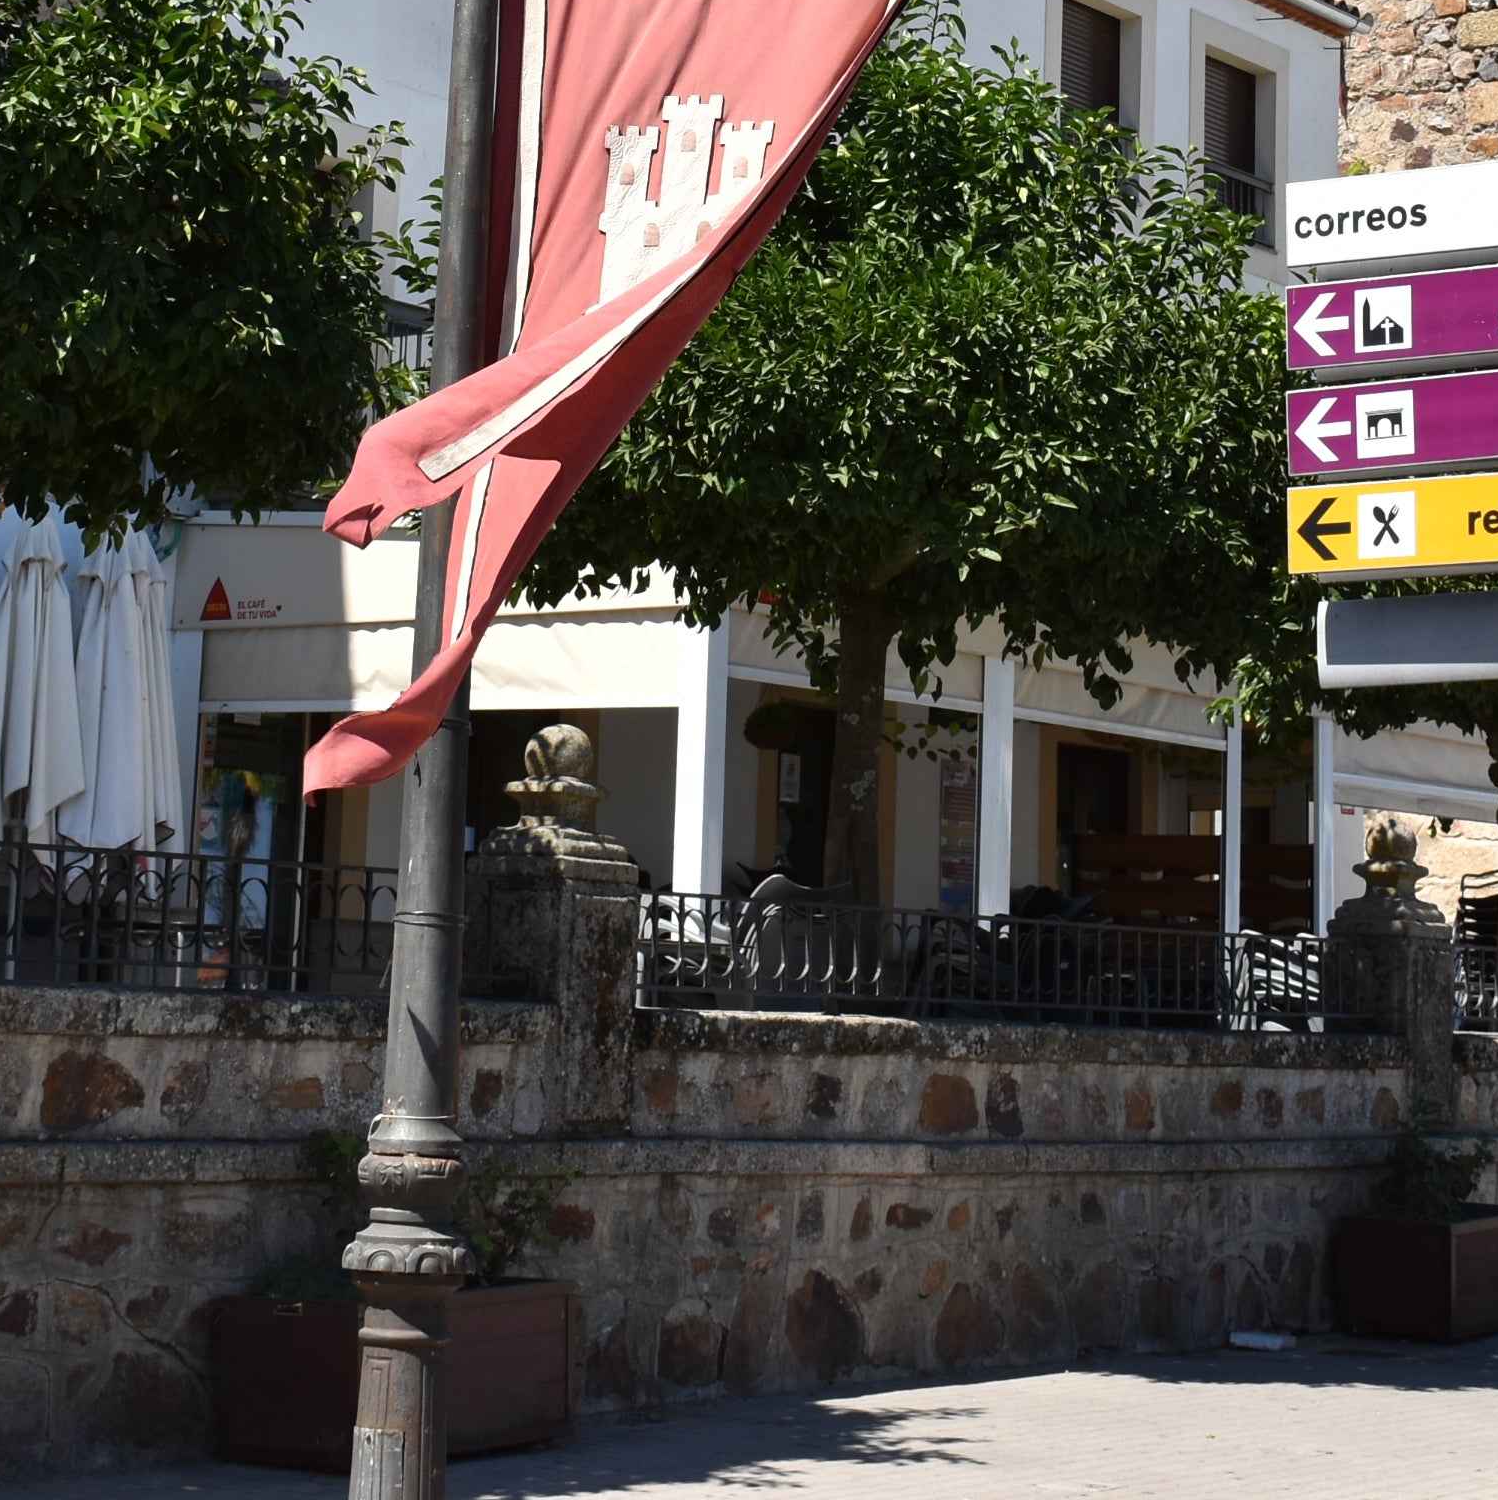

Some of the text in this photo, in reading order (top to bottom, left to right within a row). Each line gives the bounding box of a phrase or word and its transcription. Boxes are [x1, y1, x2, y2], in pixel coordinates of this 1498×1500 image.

[1294, 201, 1428, 239] correos
[237, 601, 246, 609] EL
[237, 610, 277, 620] DE TU VIDA
